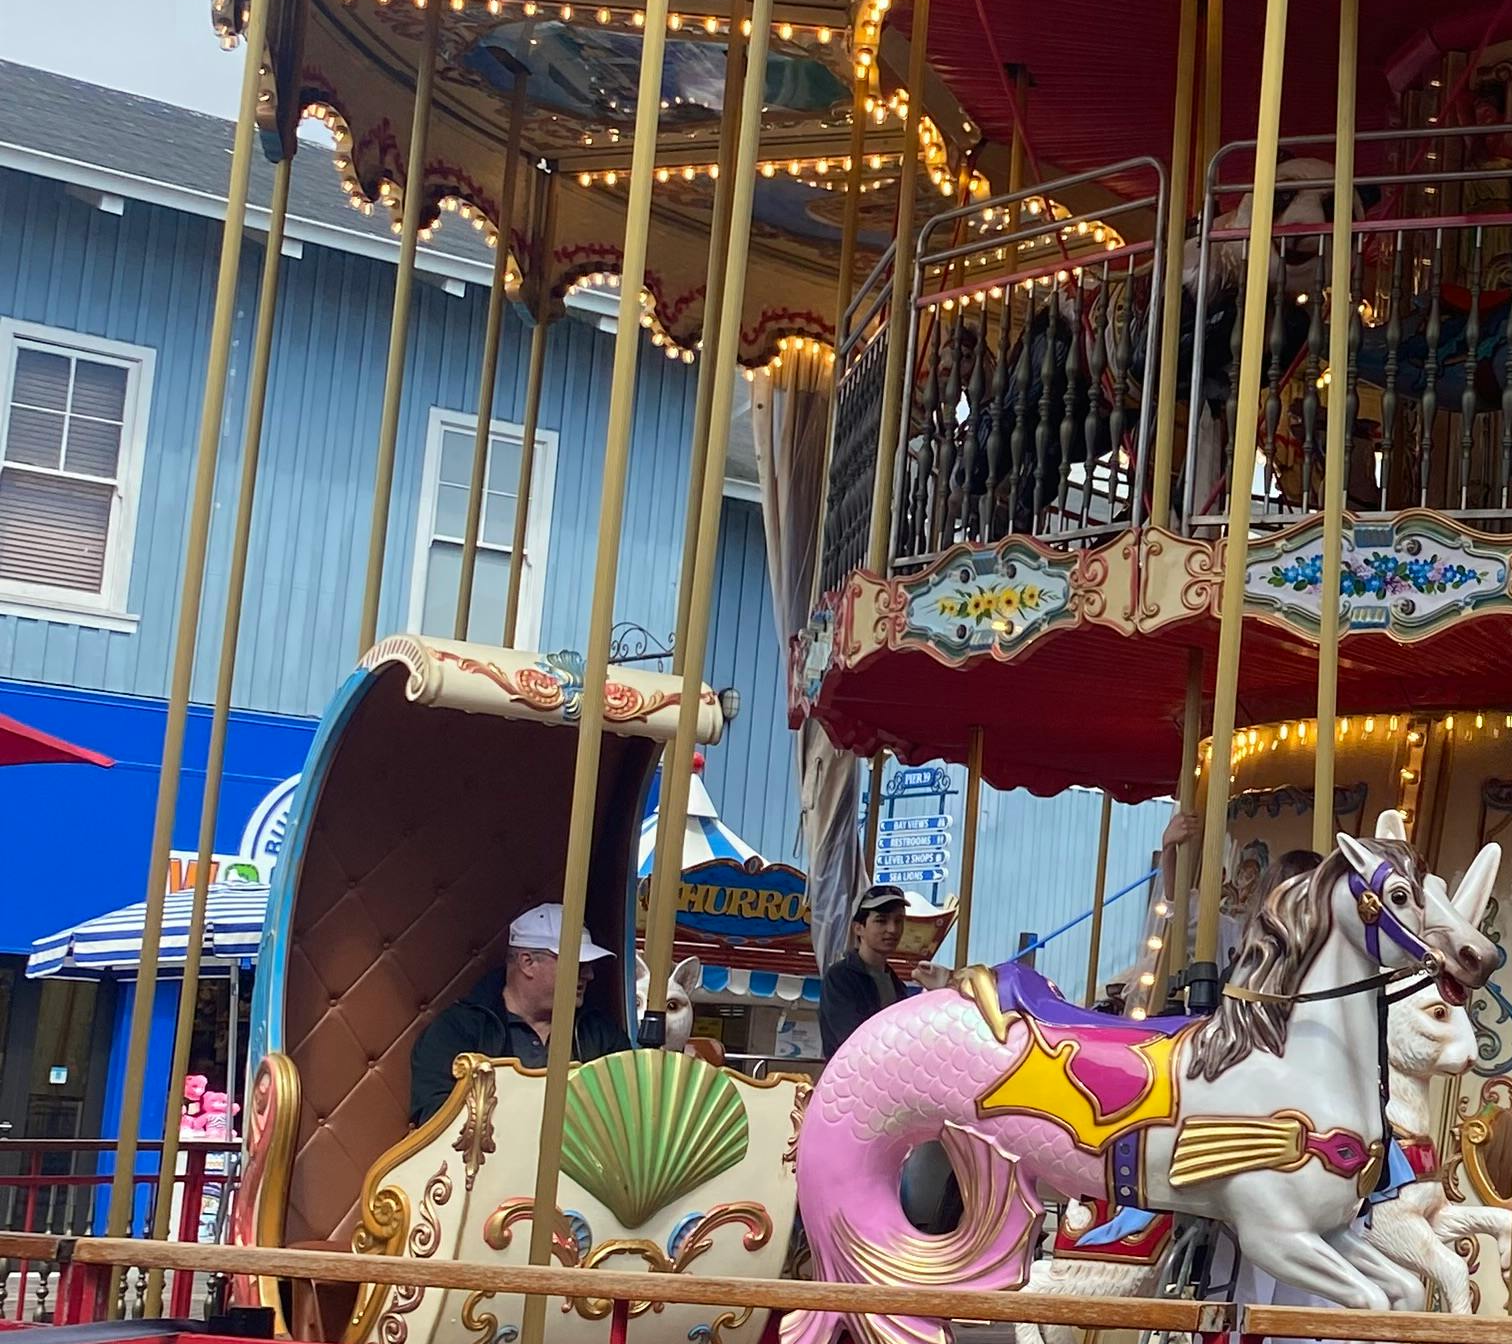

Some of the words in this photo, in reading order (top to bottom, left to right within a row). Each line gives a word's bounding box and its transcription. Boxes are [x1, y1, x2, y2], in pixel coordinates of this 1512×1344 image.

[905, 773, 922, 786] PIER
[893, 820, 907, 831] BAY
[908, 819, 930, 830] VIEWS
[890, 836, 931, 847] RESTROOMS
[884, 855, 904, 865] LEVEL
[905, 854, 910, 864] 2
[911, 852, 934, 863] SHOPS
[889, 872, 901, 882] SEA
[902, 871, 924, 881] LIONS
[679, 884, 814, 924] HURRO
